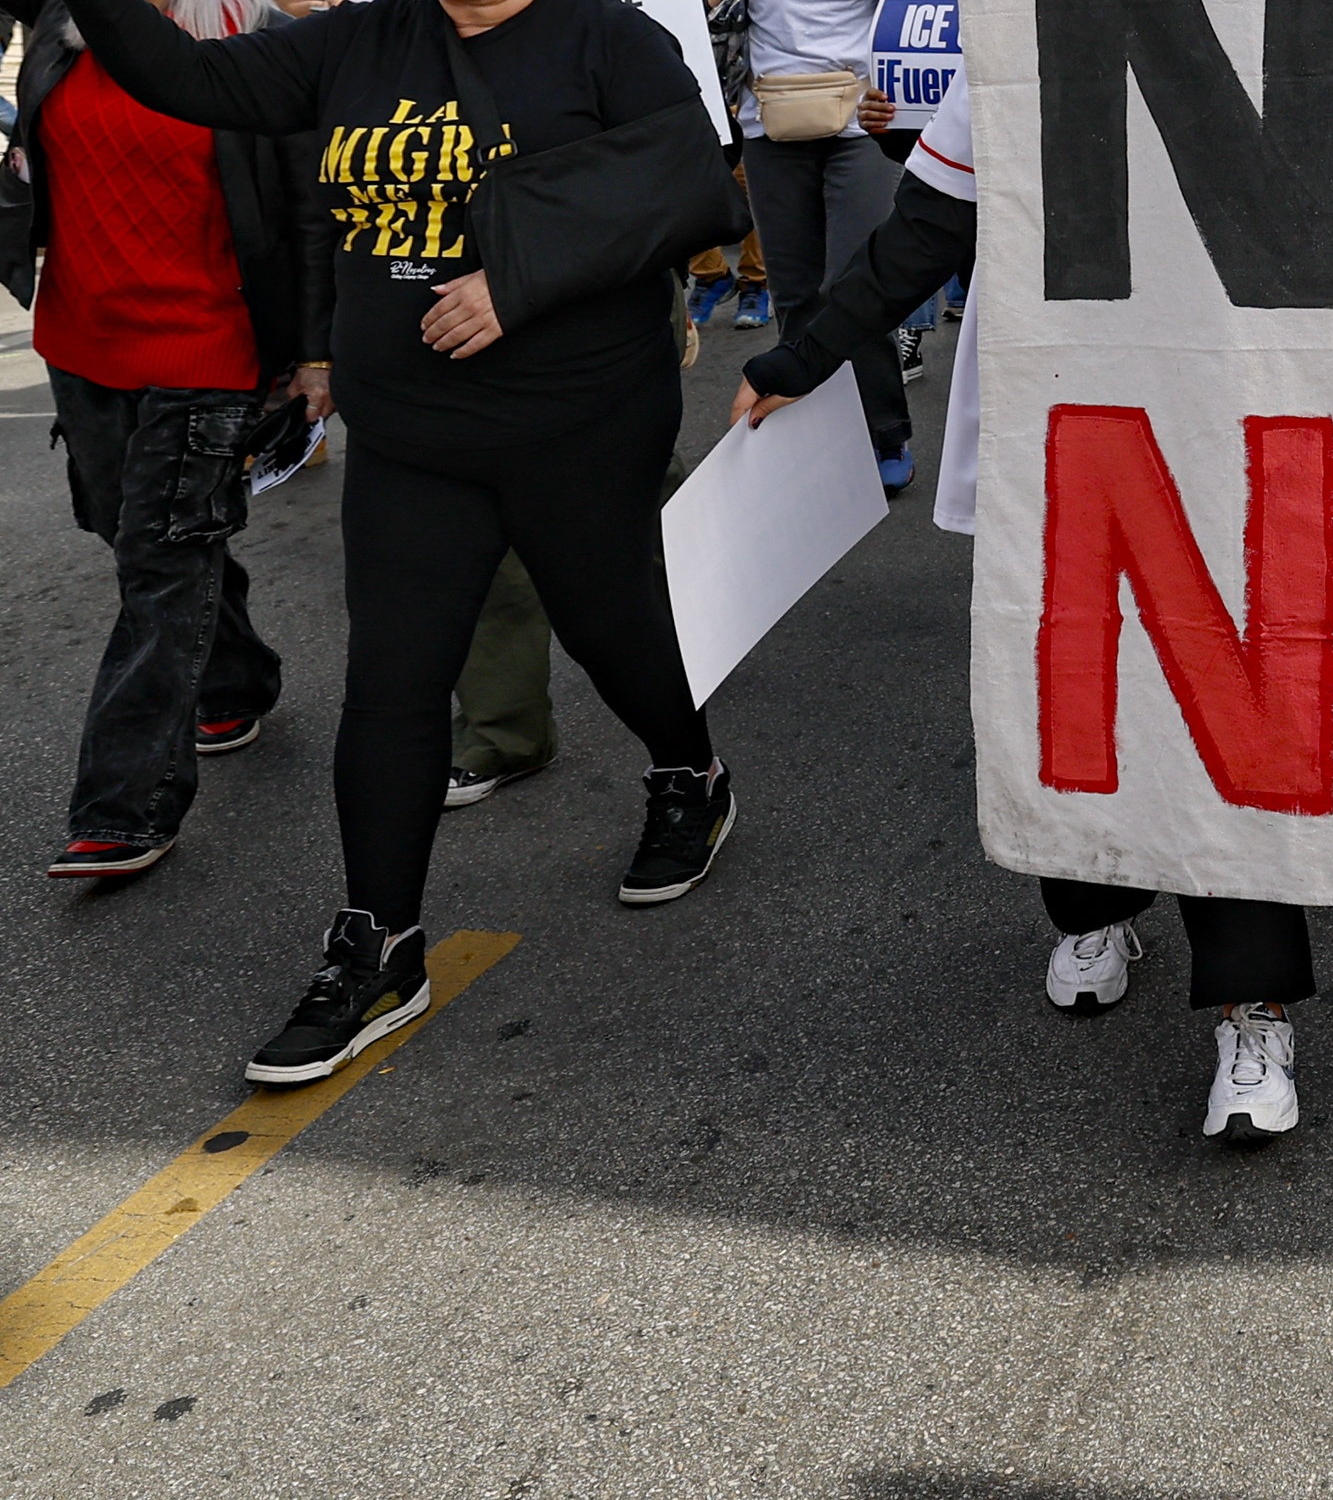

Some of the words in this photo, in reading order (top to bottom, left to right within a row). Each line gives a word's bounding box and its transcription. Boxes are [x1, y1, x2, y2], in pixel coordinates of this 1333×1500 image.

[898, 3, 955, 49] ICE
[877, 58, 957, 106] ¡Fuer
[388, 98, 460, 124] LA
